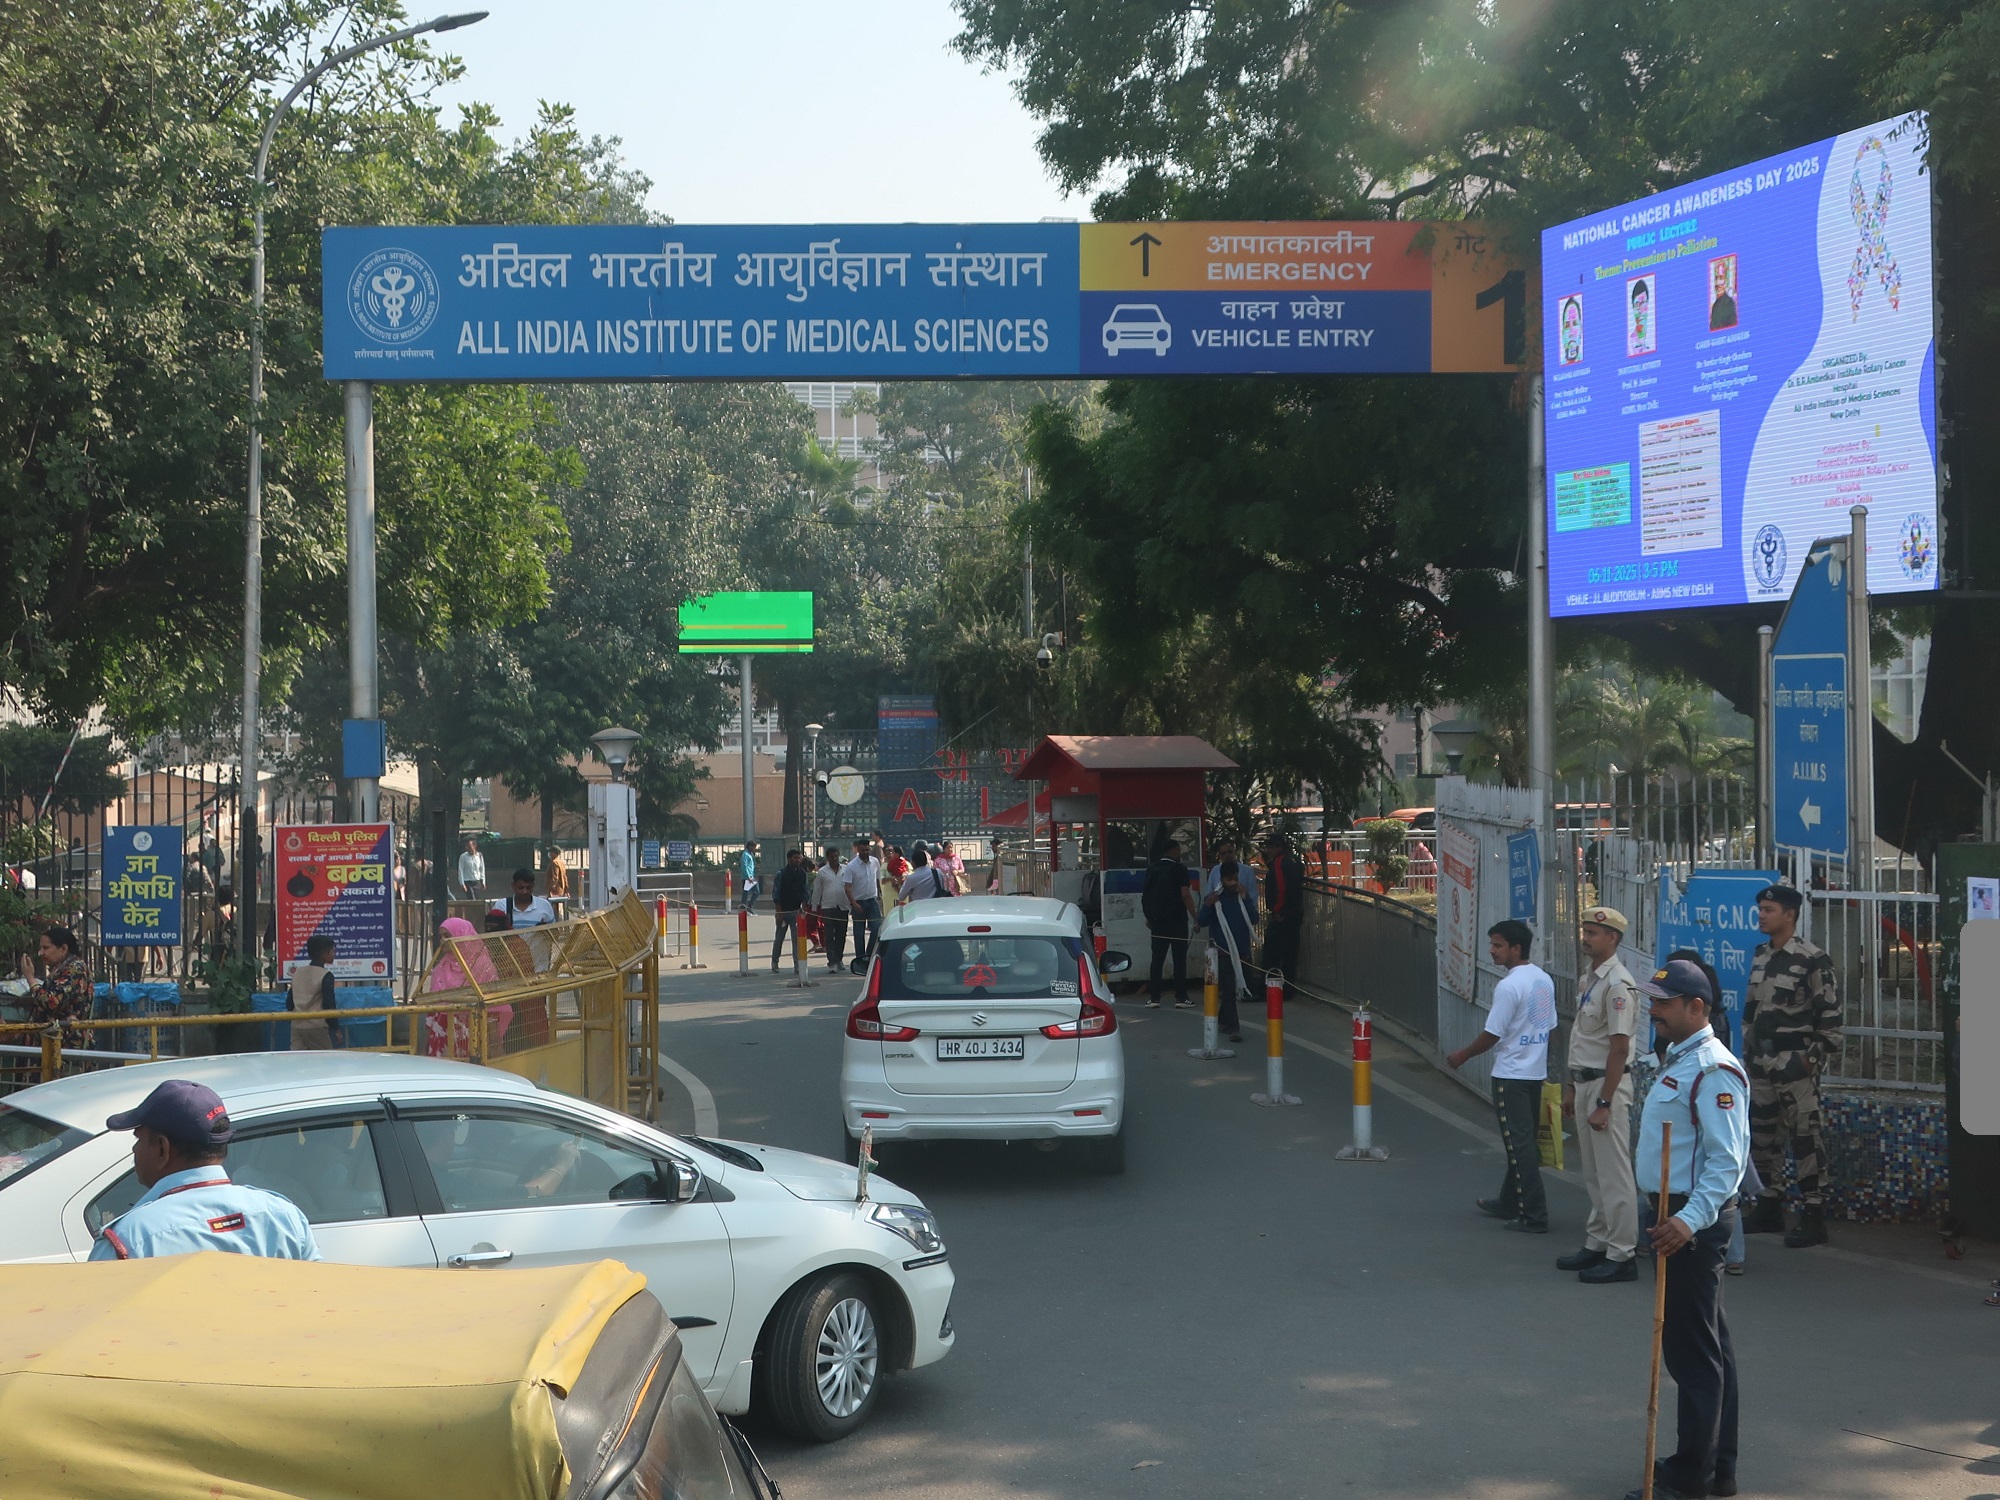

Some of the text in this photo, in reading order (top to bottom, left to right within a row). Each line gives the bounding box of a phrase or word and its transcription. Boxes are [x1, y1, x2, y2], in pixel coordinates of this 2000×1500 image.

[1564, 156, 1820, 250] NATIONAL CANCER AWARENESS DAY 2025
[1207, 230, 1375, 254] आपातकालीन
[1626, 218, 1698, 251] PUBLIC LECTURE
[457, 238, 1048, 302] अखिल भारतीय आयुर्विज्ञान संस्थान
[1207, 262, 1373, 280] EMERGENCY
[1623, 250, 1666, 272] Prevention
[1221, 295, 1345, 321] वाहन प्रवेश
[1476, 270, 1526, 364] 1
[457, 318, 1049, 354] ALL INDIA INSTITUTE OF MEDICAL SCIENCES
[1192, 329, 1375, 347] VEHICLE ENTRY
[1660, 560, 1679, 577] PM
[1603, 589, 1646, 602] AUDITORIUM
[308, 830, 378, 845] दिल्ली पुलिस
[126, 856, 160, 874] जन
[326, 864, 386, 884] बम्ब
[108, 873, 176, 900] औषधि
[327, 886, 340, 897] हो
[342, 887, 374, 896] सकता
[122, 902, 161, 928] केंद्र
[1720, 940, 1746, 975] लिए
[946, 1041, 1022, 1054] HR 40J 3434
